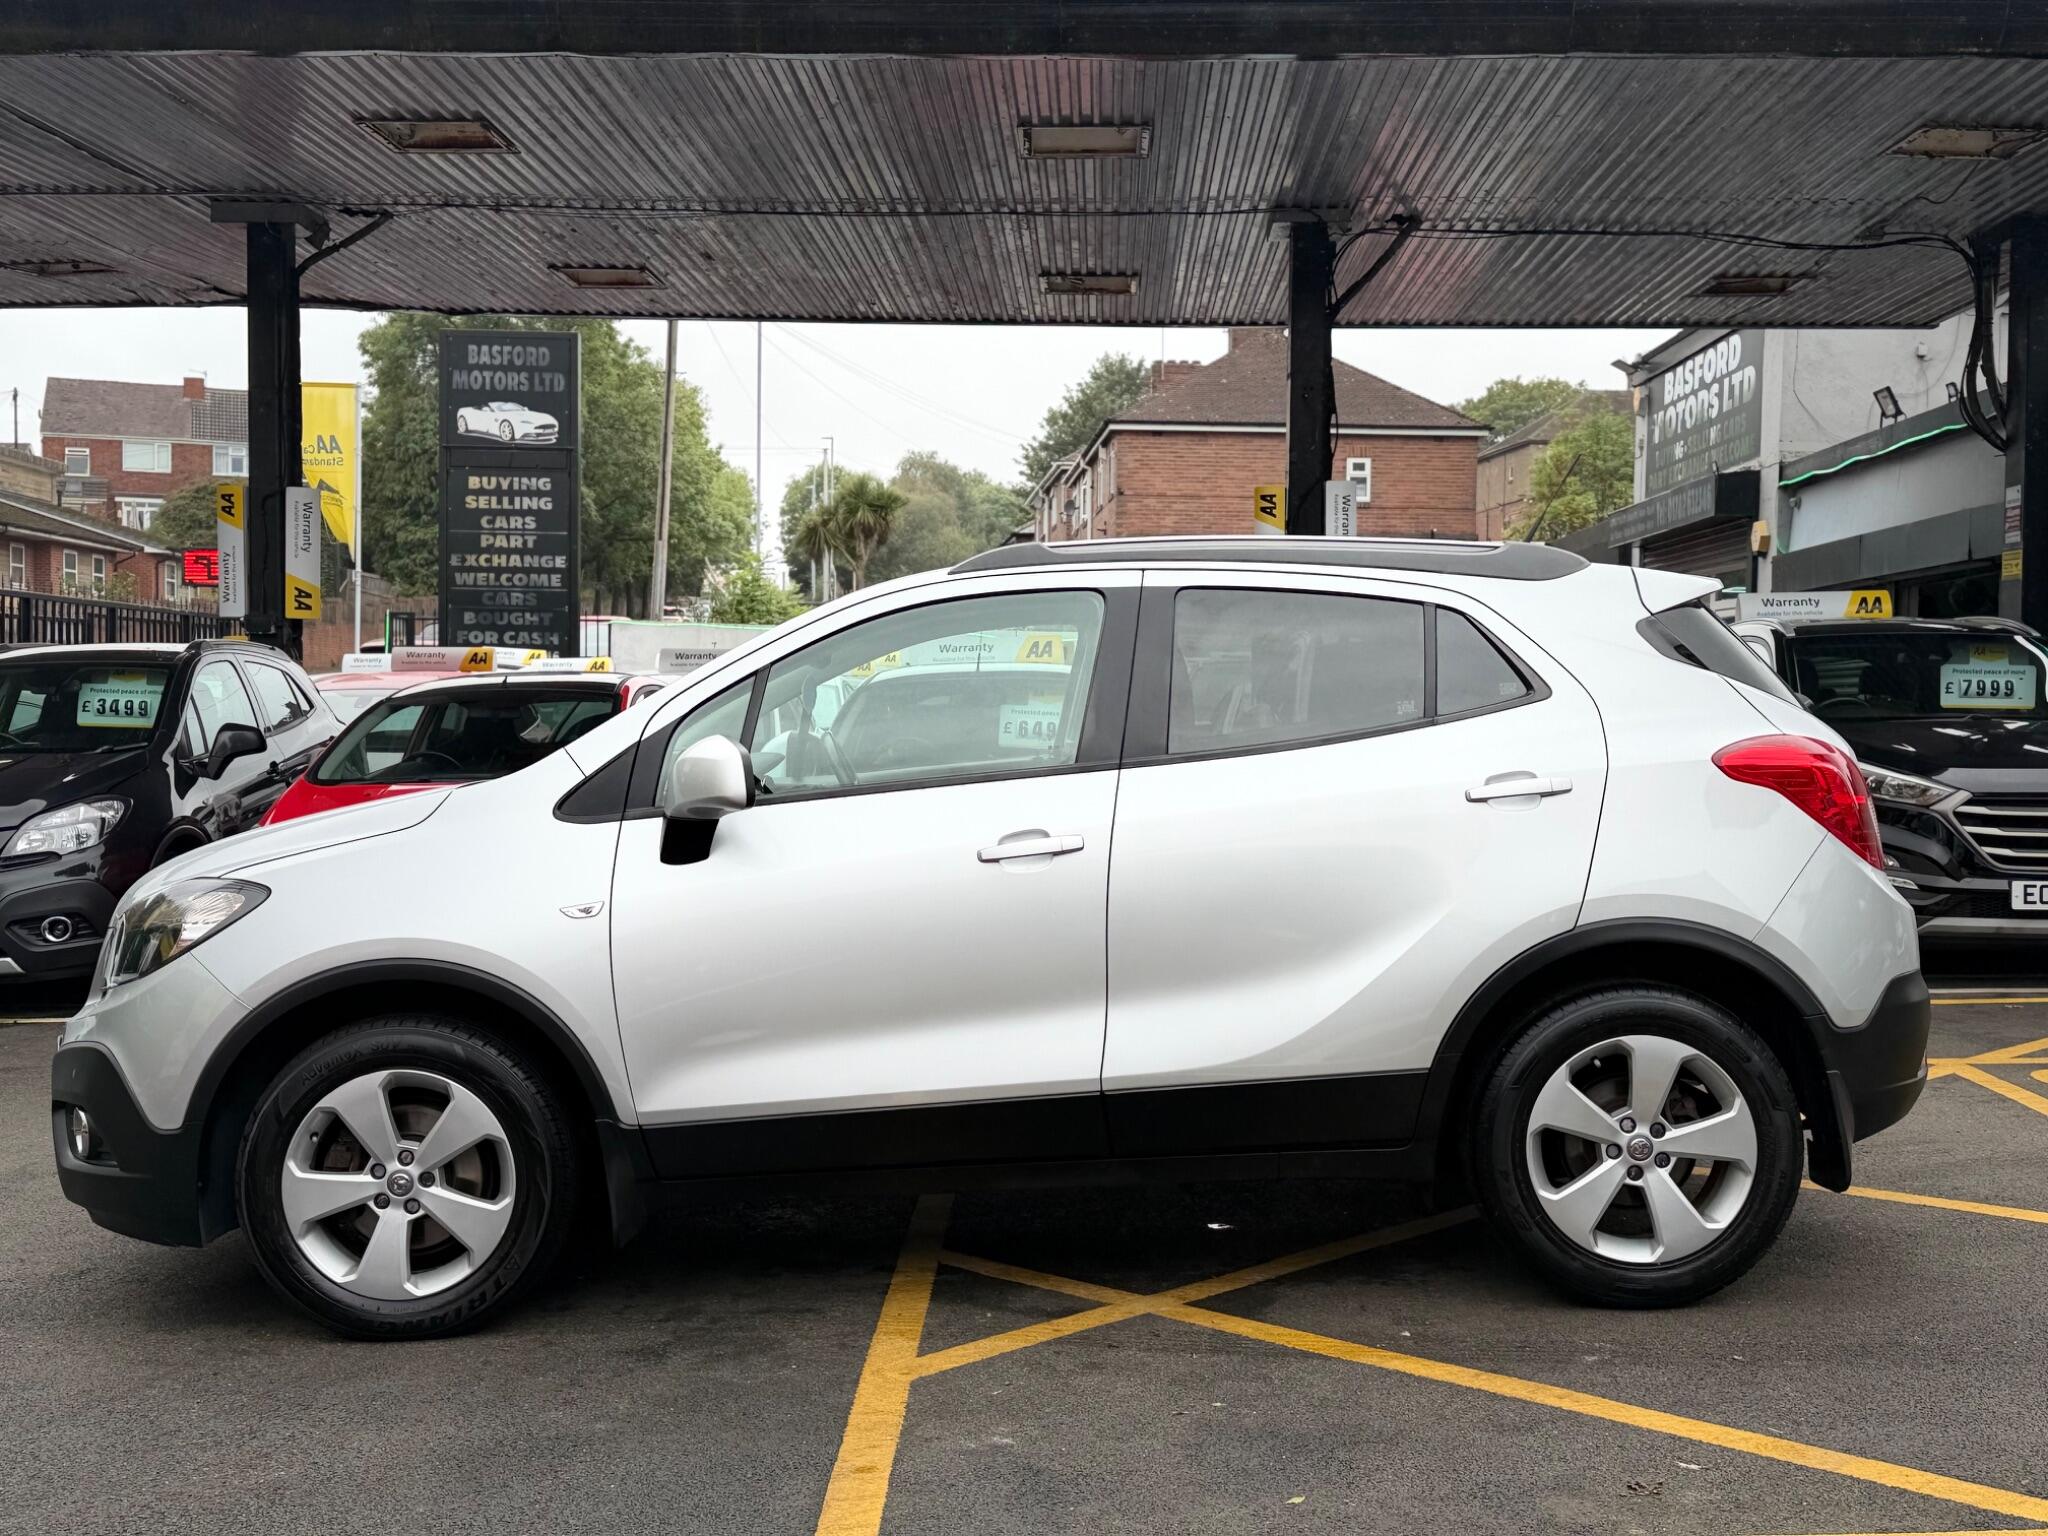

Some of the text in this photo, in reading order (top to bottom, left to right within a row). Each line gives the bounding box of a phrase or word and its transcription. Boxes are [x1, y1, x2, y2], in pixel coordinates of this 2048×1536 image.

[467, 344, 551, 366] BASFORD
[1664, 334, 1742, 406] BASFORD
[452, 369, 566, 392] MOTORS LTD
[1722, 365, 1756, 413] LTD
[468, 476, 552, 491] BUYING
[220, 493, 235, 518] AA
[464, 495, 553, 510] SELLING
[1259, 493, 1277, 519] AA
[480, 515, 537, 530] CARS
[1342, 494, 1351, 536] Warran
[300, 501, 313, 553] Warranty
[480, 534, 537, 549] PART
[449, 553, 567, 569] EXCHANGE
[222, 552, 232, 604] Warranty
[454, 571, 562, 587] WELCOME
[294, 586, 313, 611] AA
[481, 592, 538, 606] CARS
[1760, 596, 1883, 614] Warranty AA
[463, 611, 554, 626] BOUGHT
[456, 630, 560, 645] FOR CASH
[939, 640, 1053, 658] Warranty AA
[405, 651, 488, 665] Warranty AA
[590, 661, 605, 671] AA
[884, 654, 897, 663] AA
